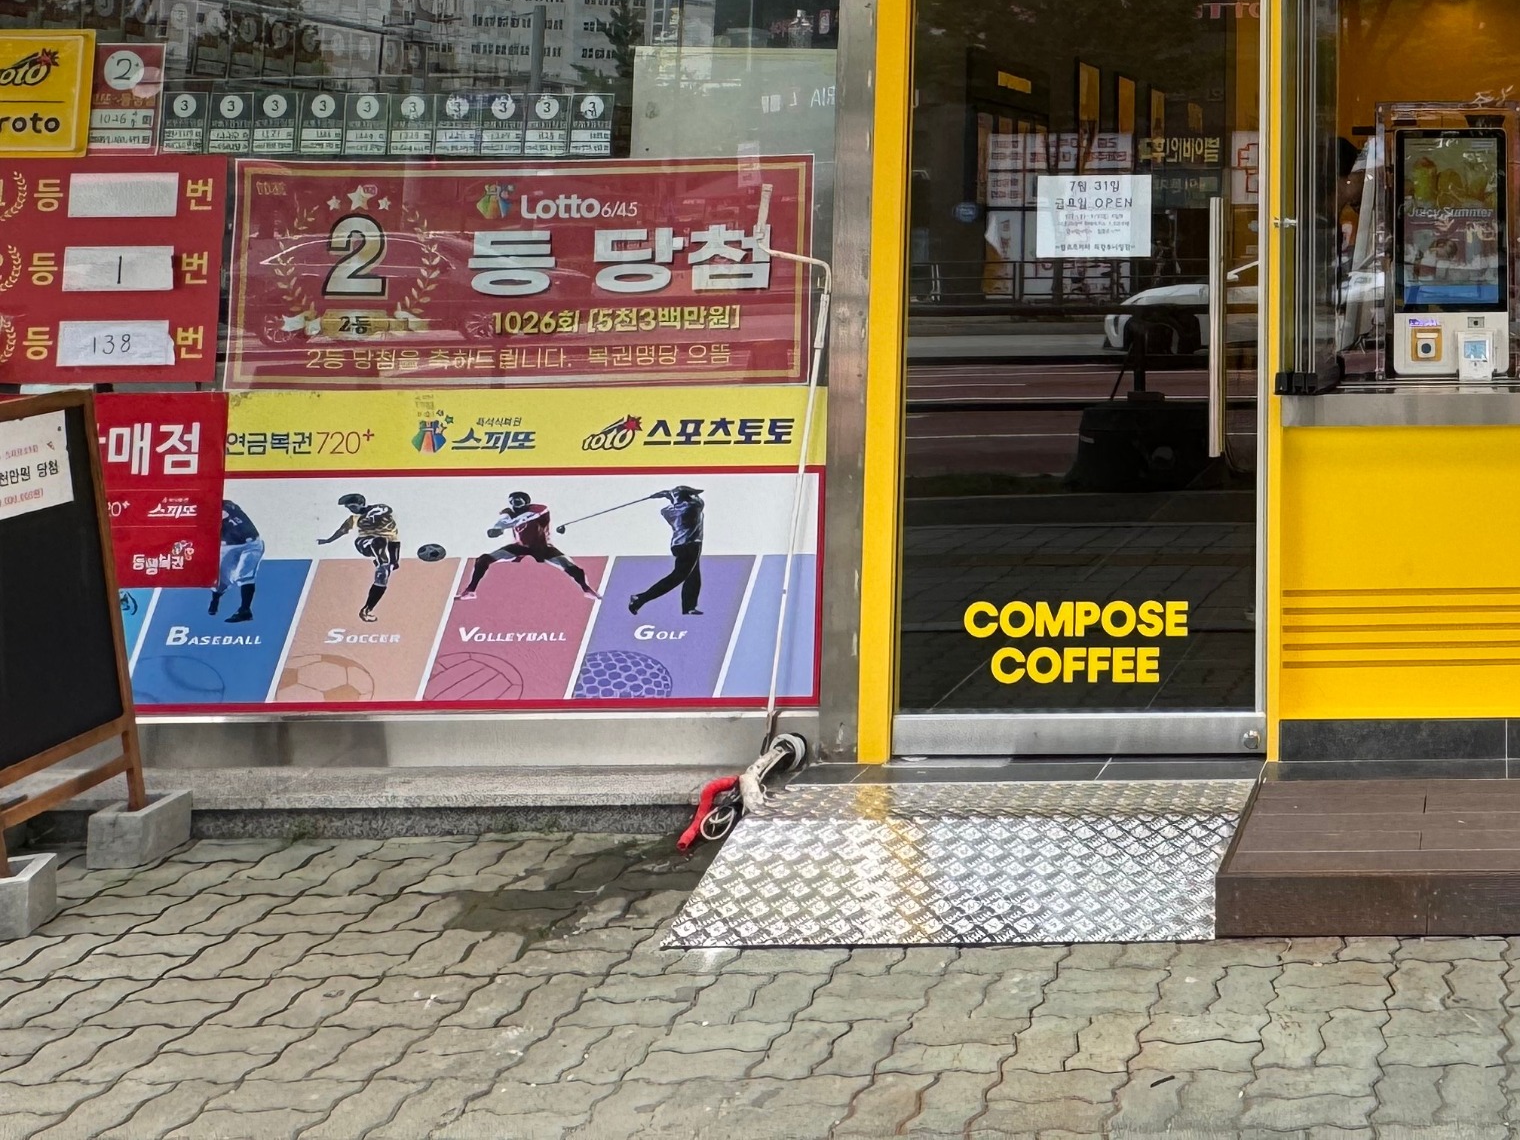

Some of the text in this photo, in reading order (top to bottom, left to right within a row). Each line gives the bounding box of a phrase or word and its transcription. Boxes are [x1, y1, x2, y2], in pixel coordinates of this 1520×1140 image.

[113, 58, 132, 81] 2
[34, 177, 213, 212] 등 번
[1069, 180, 1120, 193] 7월 31일
[520, 194, 638, 220] Lotto 6/45
[1094, 197, 1133, 209] OPEN
[28, 252, 58, 286] 등
[181, 251, 208, 285] 번
[321, 213, 389, 300] 2
[468, 223, 771, 297] 등 당첨
[338, 315, 371, 335] 2등
[491, 309, 581, 334] 1026회
[23, 325, 204, 360] 등 138 번
[306, 348, 344, 370] 2등
[353, 348, 420, 371] 당첨을
[587, 345, 680, 367] 복권명당
[687, 343, 731, 366] 으뜸
[226, 431, 313, 456] 연금복권
[452, 427, 537, 454] 스피또
[643, 416, 795, 446] 스포츠토토
[98, 421, 201, 476] 매점
[147, 503, 198, 519] 스피또
[963, 600, 1189, 639] COMPOSE
[990, 646, 1160, 685] COFFEE
